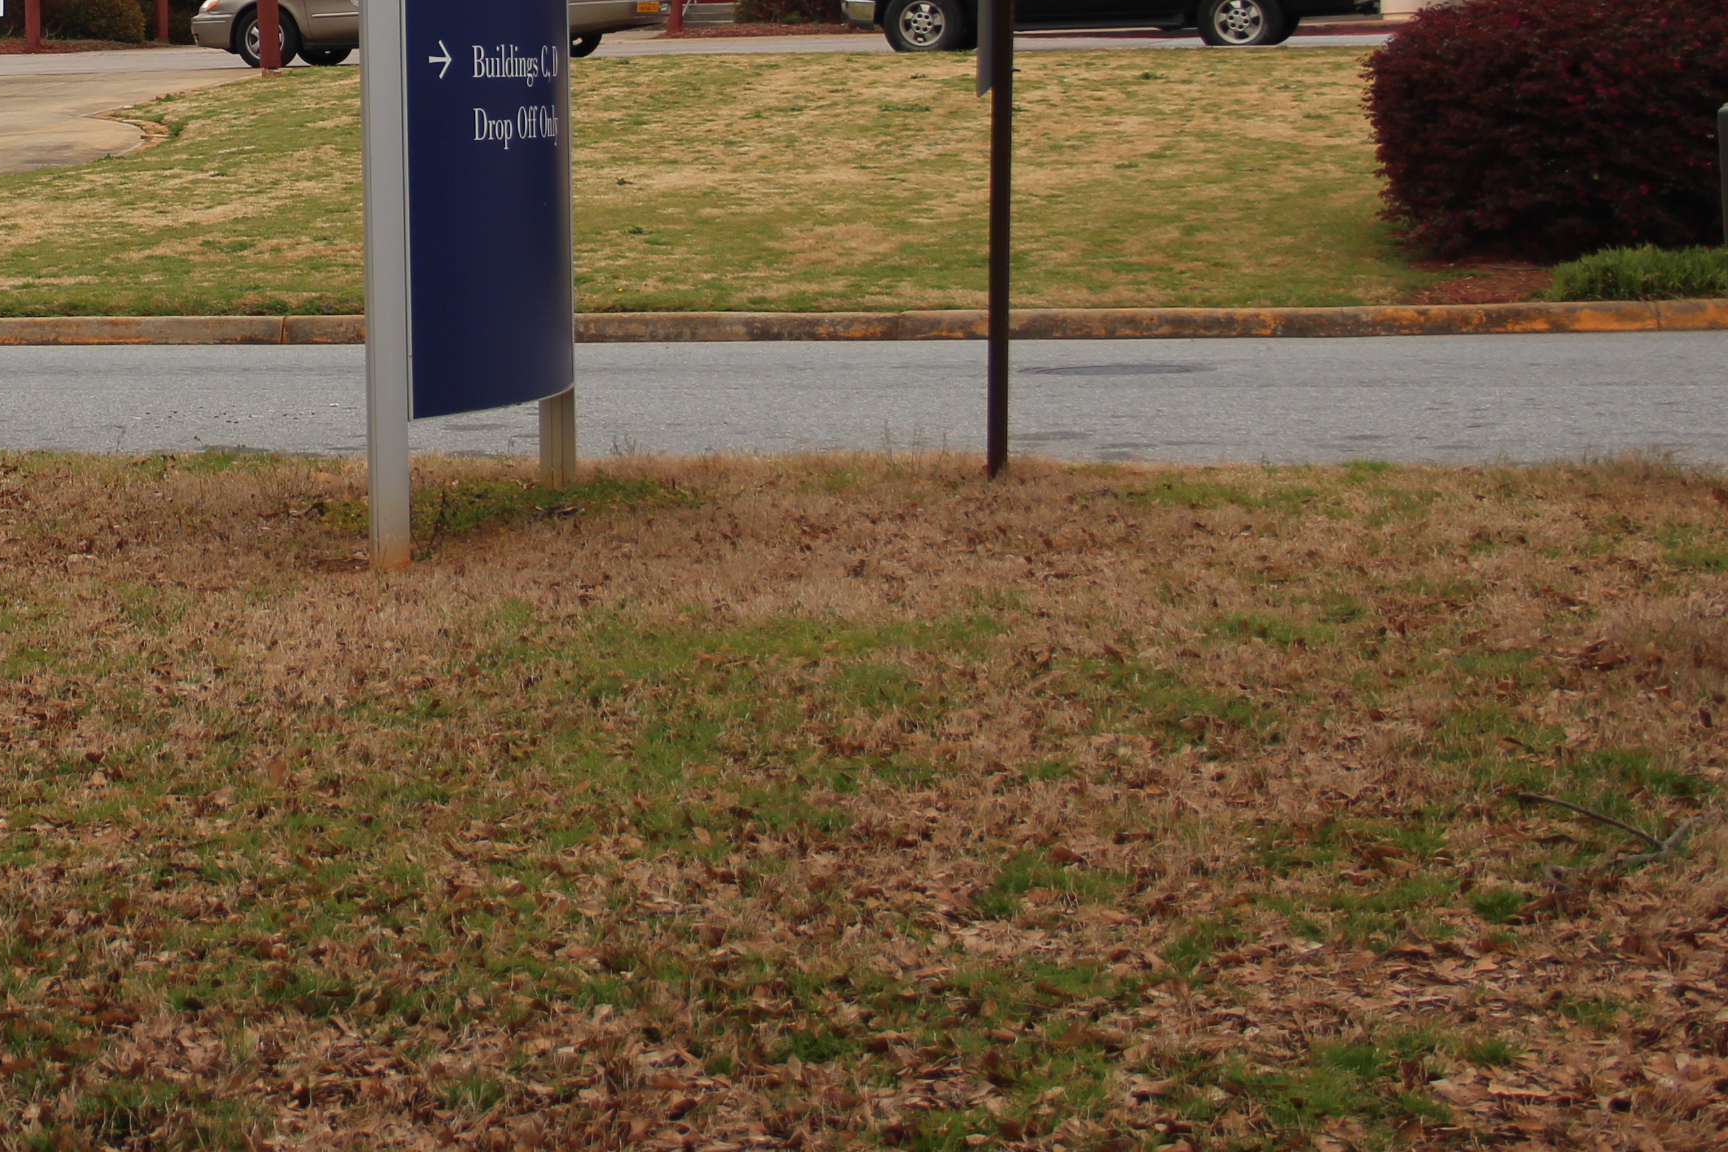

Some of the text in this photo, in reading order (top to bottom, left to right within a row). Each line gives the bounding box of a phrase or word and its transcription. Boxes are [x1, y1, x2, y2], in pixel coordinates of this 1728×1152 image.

[472, 44, 538, 87] Buildings
[540, 45, 551, 83] C,
[473, 104, 558, 150] Drop Off Only
